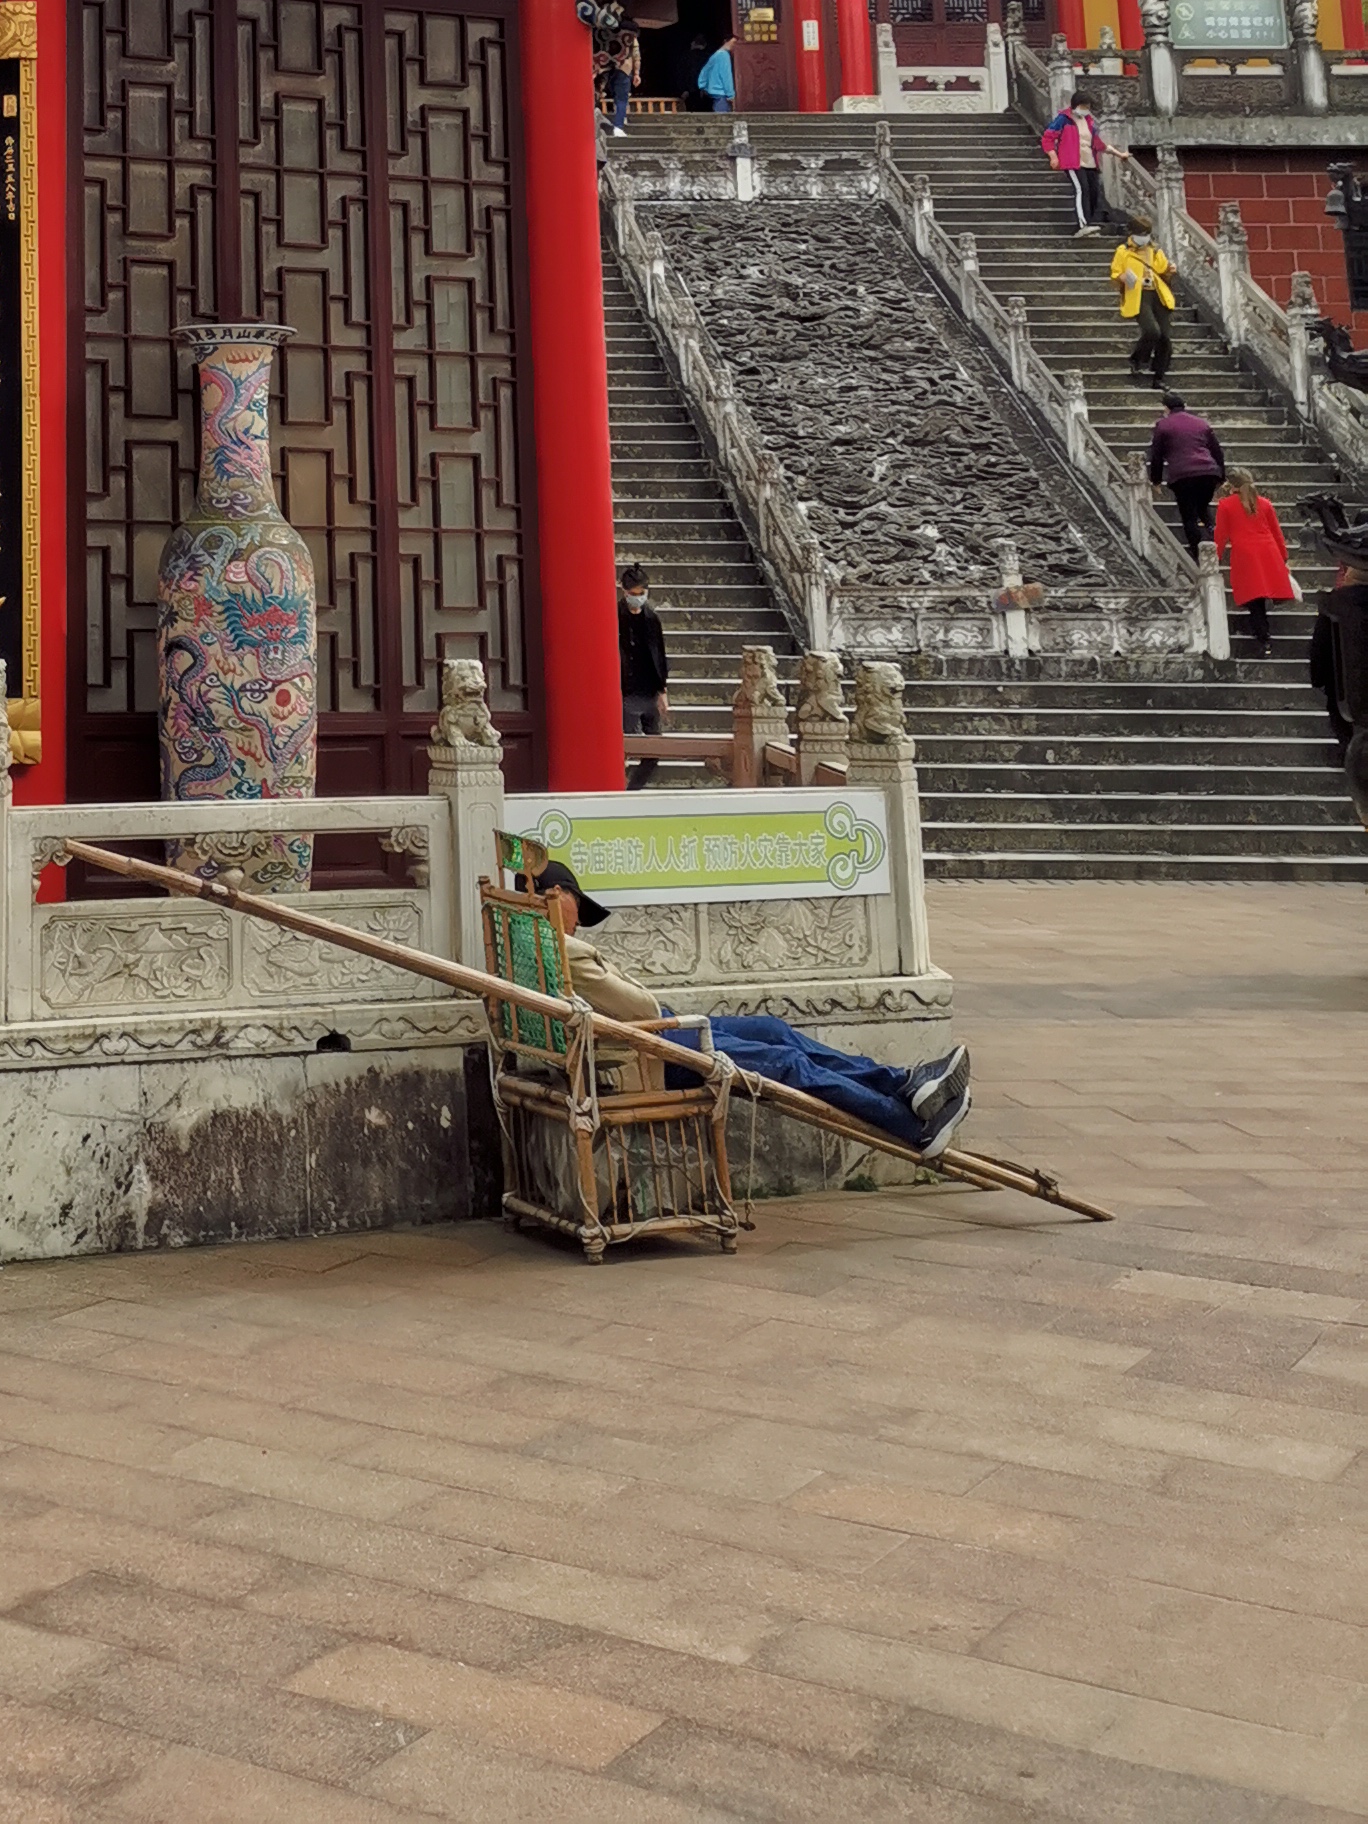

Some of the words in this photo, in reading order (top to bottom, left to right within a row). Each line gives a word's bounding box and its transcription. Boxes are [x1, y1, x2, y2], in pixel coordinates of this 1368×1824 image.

[571, 836, 699, 875] 寺庙消防人人抓
[703, 832, 828, 870] 预防火灾靠大家
